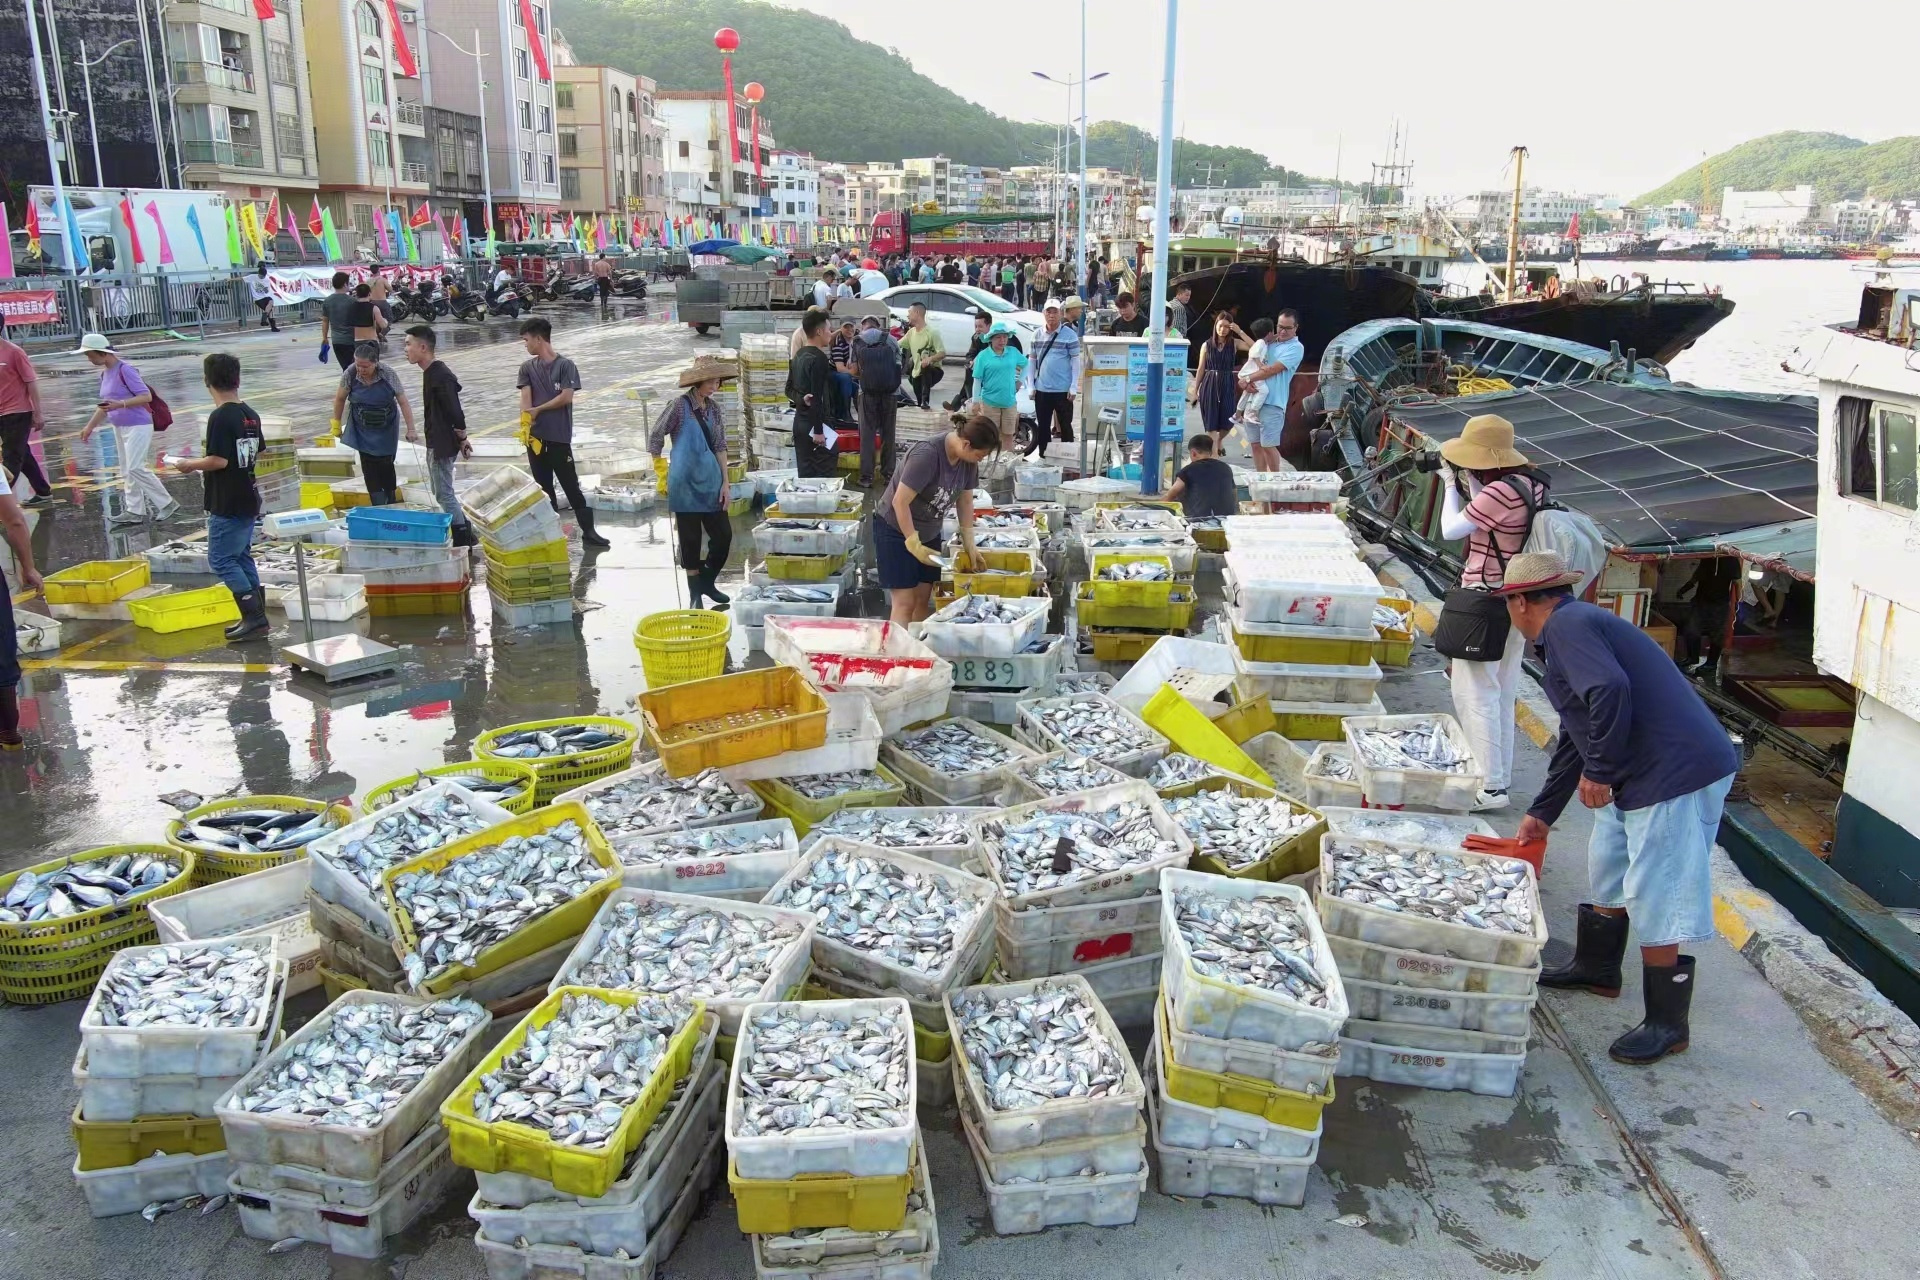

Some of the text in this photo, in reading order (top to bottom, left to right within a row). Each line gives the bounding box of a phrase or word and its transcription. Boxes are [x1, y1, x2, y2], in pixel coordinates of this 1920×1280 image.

[675, 861, 727, 880] 39222
[1392, 994, 1452, 1011] 23089
[1391, 1052, 1447, 1068] 78205
